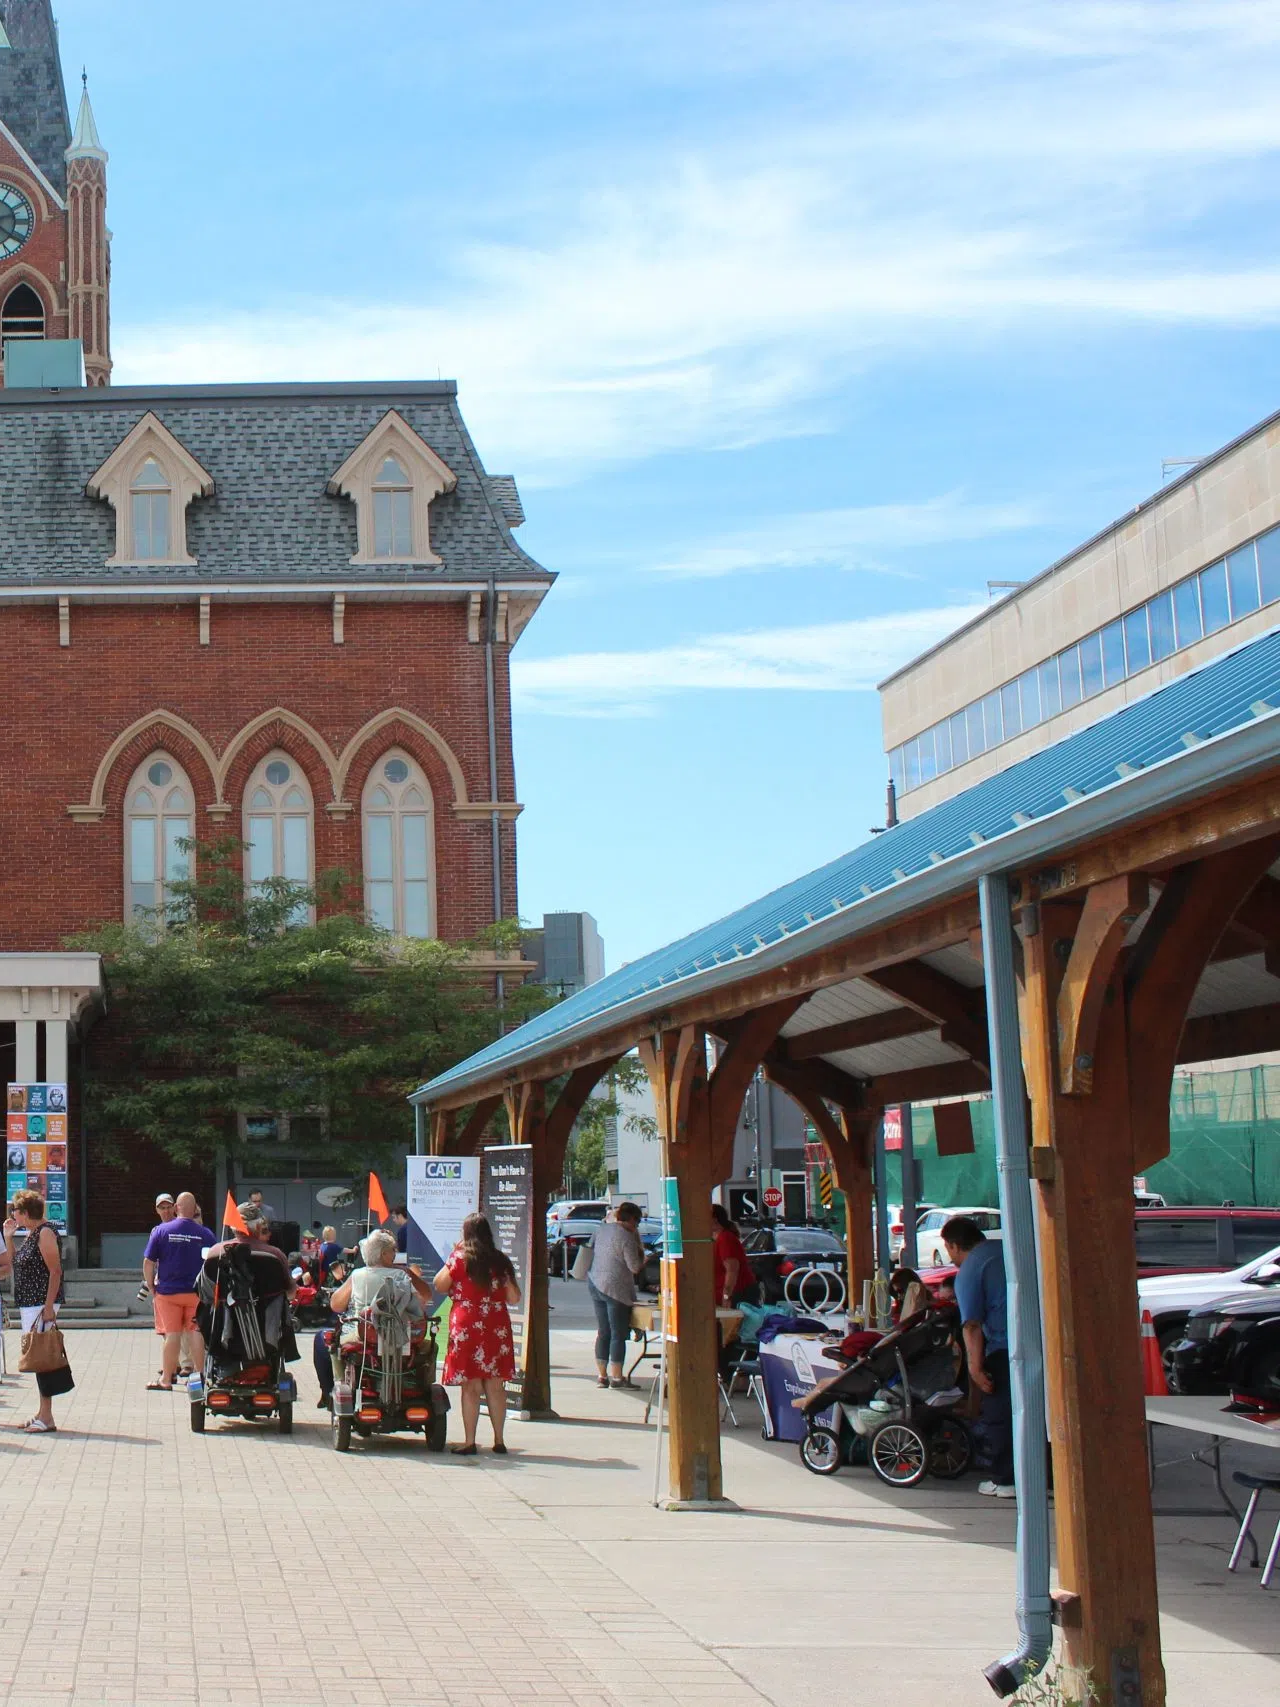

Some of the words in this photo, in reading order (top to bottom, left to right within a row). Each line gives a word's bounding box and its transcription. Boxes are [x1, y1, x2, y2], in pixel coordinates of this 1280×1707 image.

[426, 1163, 460, 1177] CATC
[491, 1165, 499, 1176] You
[510, 1165, 520, 1176] Have
[520, 1165, 526, 1176] to
[499, 1180, 505, 1192] Be
[505, 1180, 517, 1192] Alone
[764, 1194, 781, 1202] STOP
